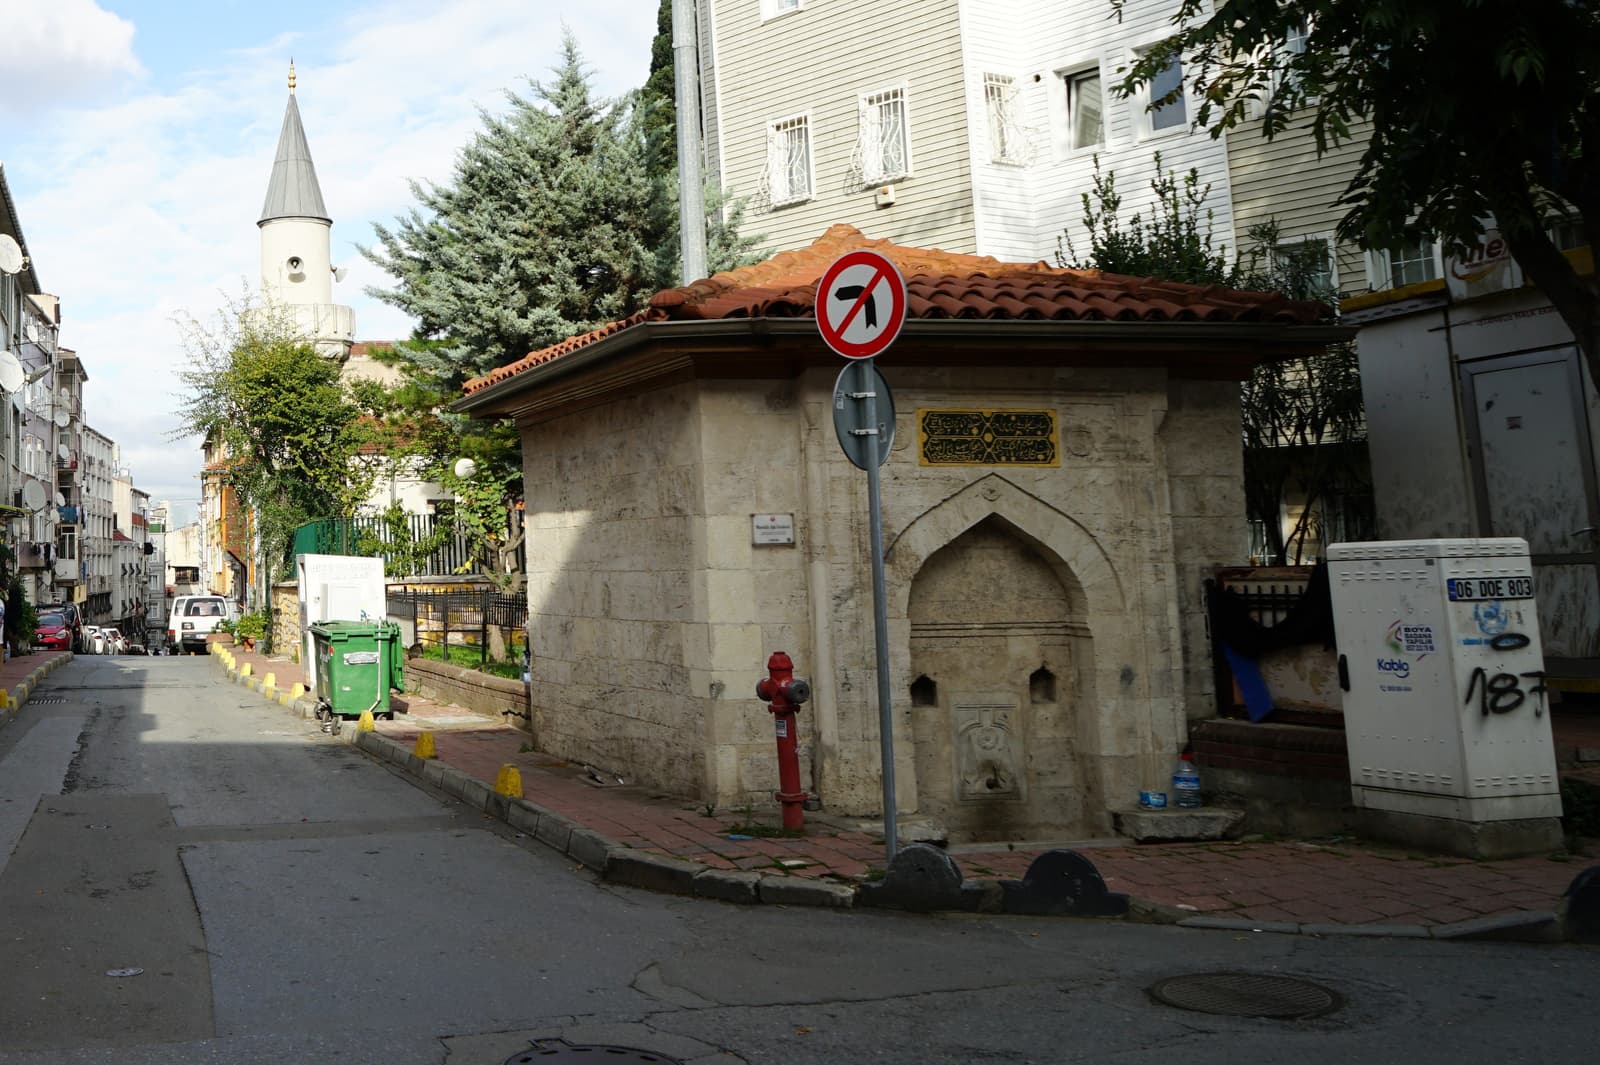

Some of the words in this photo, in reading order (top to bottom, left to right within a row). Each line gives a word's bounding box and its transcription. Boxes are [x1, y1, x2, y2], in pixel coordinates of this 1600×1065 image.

[1456, 581, 1473, 598] 06
[1479, 580, 1504, 597] DOE
[1508, 579, 1531, 596] 803
[1377, 658, 1409, 672] Kablo
